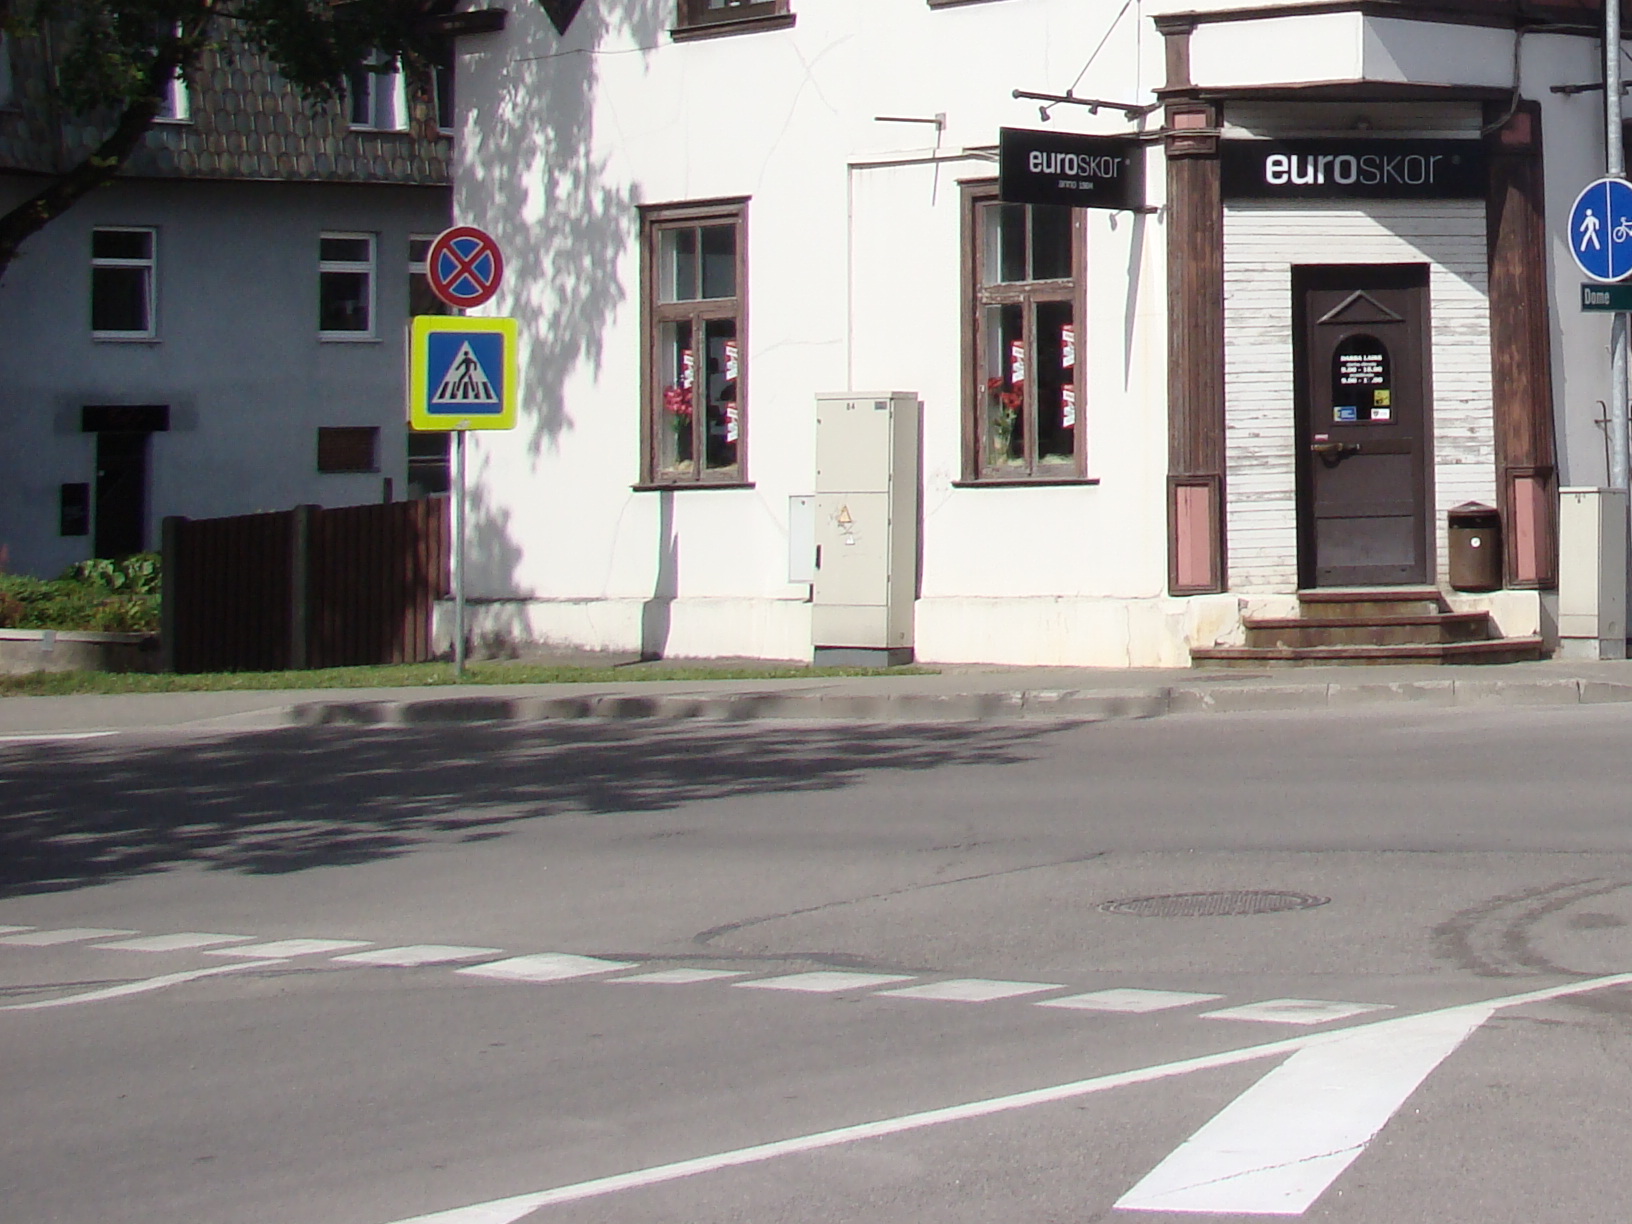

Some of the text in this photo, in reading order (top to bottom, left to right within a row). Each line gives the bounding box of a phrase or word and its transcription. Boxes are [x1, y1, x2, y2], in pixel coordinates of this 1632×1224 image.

[1029, 150, 1121, 178] euroskor
[1265, 153, 1443, 185] euroskor
[1584, 288, 1610, 305] Dome
